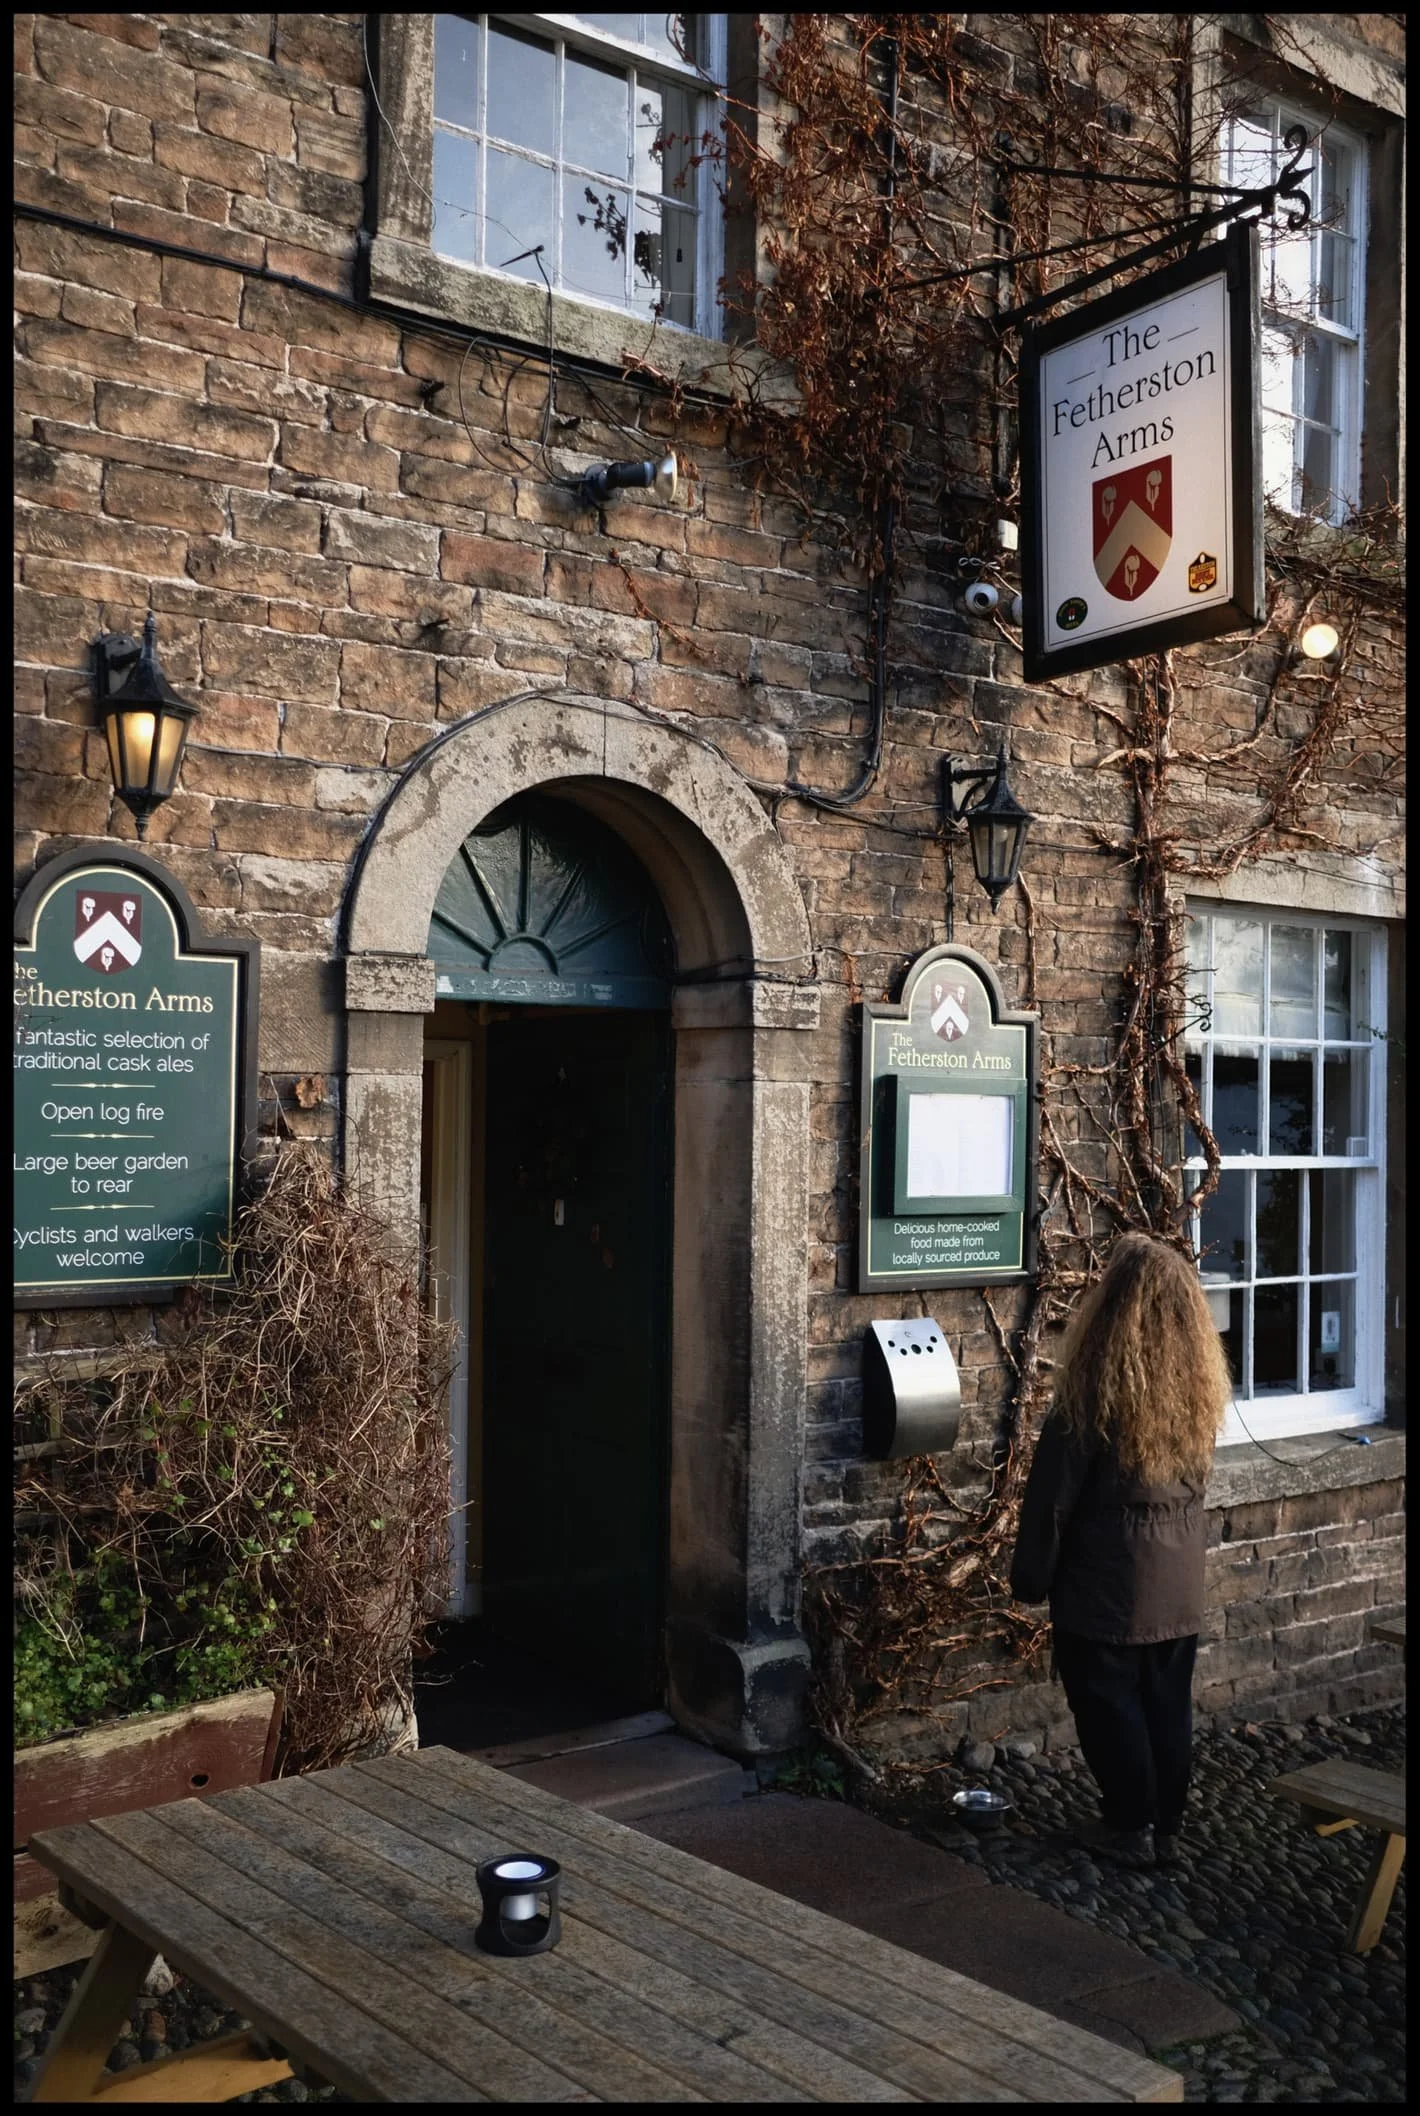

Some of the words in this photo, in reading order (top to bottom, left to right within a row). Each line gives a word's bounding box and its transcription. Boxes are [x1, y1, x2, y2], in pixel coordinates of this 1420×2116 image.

[1102, 323, 1161, 369] The
[1053, 349, 1217, 437] Fetherston
[1090, 416, 1175, 469] Arms
[14, 961, 39, 980] he
[14, 982, 137, 1010] etherston
[145, 986, 214, 1013] Arms
[16, 1026, 97, 1047] fantastic
[103, 1031, 185, 1050] selection
[191, 1033, 211, 1050] of
[892, 1032, 913, 1047] The
[107, 1054, 151, 1072] cask
[157, 1055, 194, 1073] ales
[887, 1047, 968, 1069] Fetherston
[972, 1050, 1012, 1070] Arms
[41, 1102, 94, 1124] Open
[101, 1102, 130, 1125] log
[136, 1102, 165, 1121] fire
[13, 1153, 69, 1175] Large
[75, 1153, 119, 1170] beer
[124, 1152, 189, 1175] garden
[71, 1176, 90, 1194] to
[97, 1178, 134, 1193] rear
[83, 1225, 119, 1243] and
[124, 1223, 195, 1242] walkers
[894, 1222, 935, 1235] Delicious
[937, 1220, 1000, 1233] home-cooked
[910, 1237, 932, 1249] food
[934, 1236, 960, 1248] made
[962, 1235, 984, 1247] from
[56, 1249, 145, 1268] welcome
[892, 1252, 923, 1266] locally
[925, 1250, 962, 1263] sourced
[964, 1249, 1001, 1264] produce
